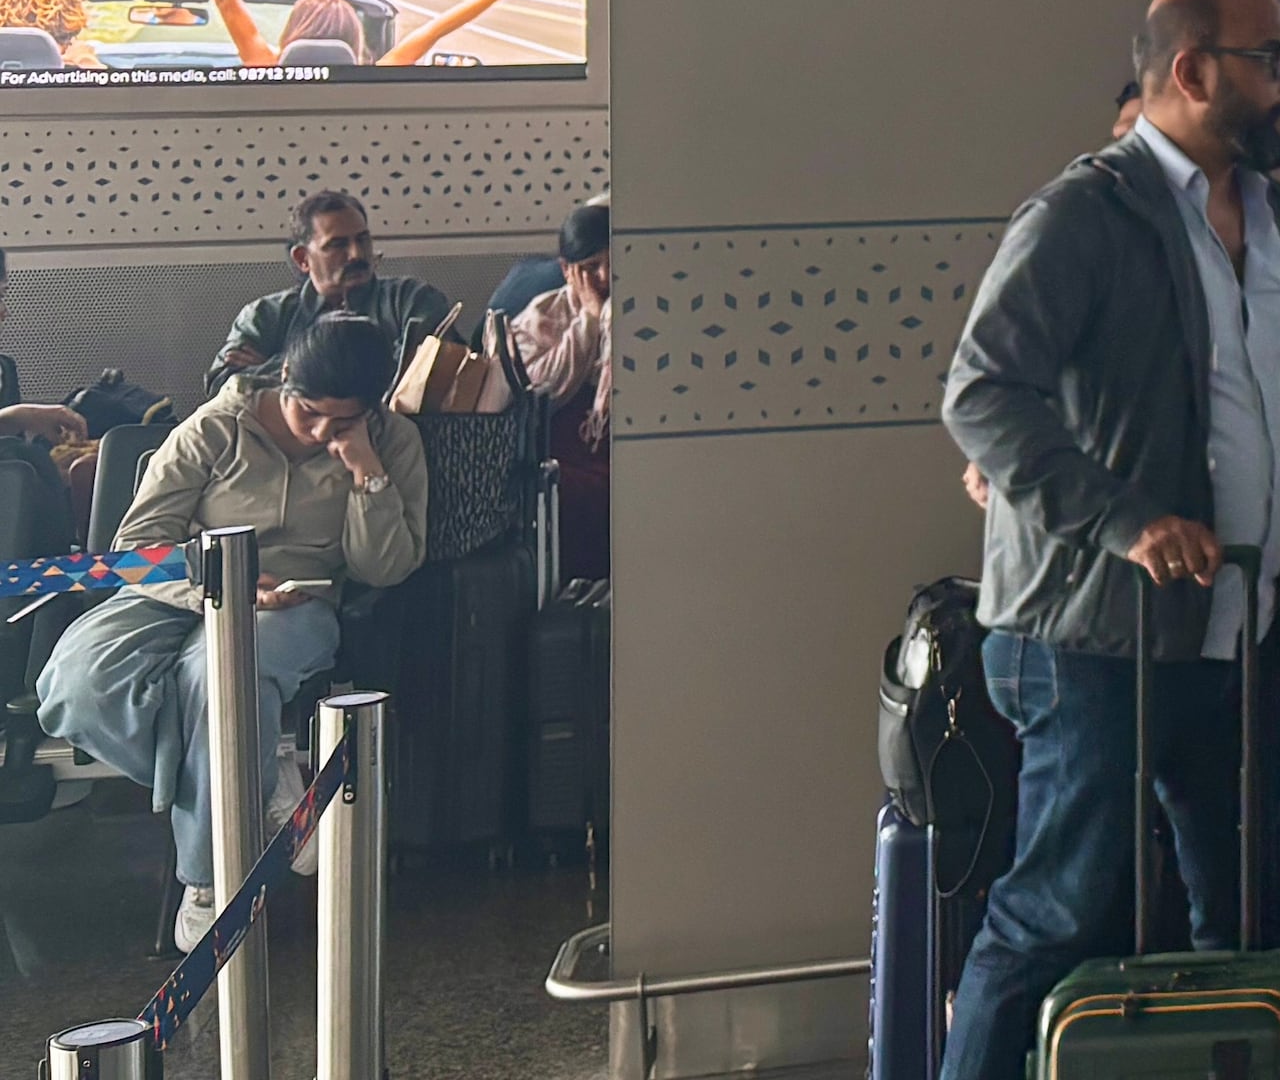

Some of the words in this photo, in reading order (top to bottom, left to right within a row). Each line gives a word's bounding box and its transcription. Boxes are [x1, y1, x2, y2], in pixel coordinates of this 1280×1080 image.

[1, 72, 26, 85] For
[27, 71, 108, 85] Advertising
[110, 72, 130, 83] on
[131, 70, 157, 82] this
